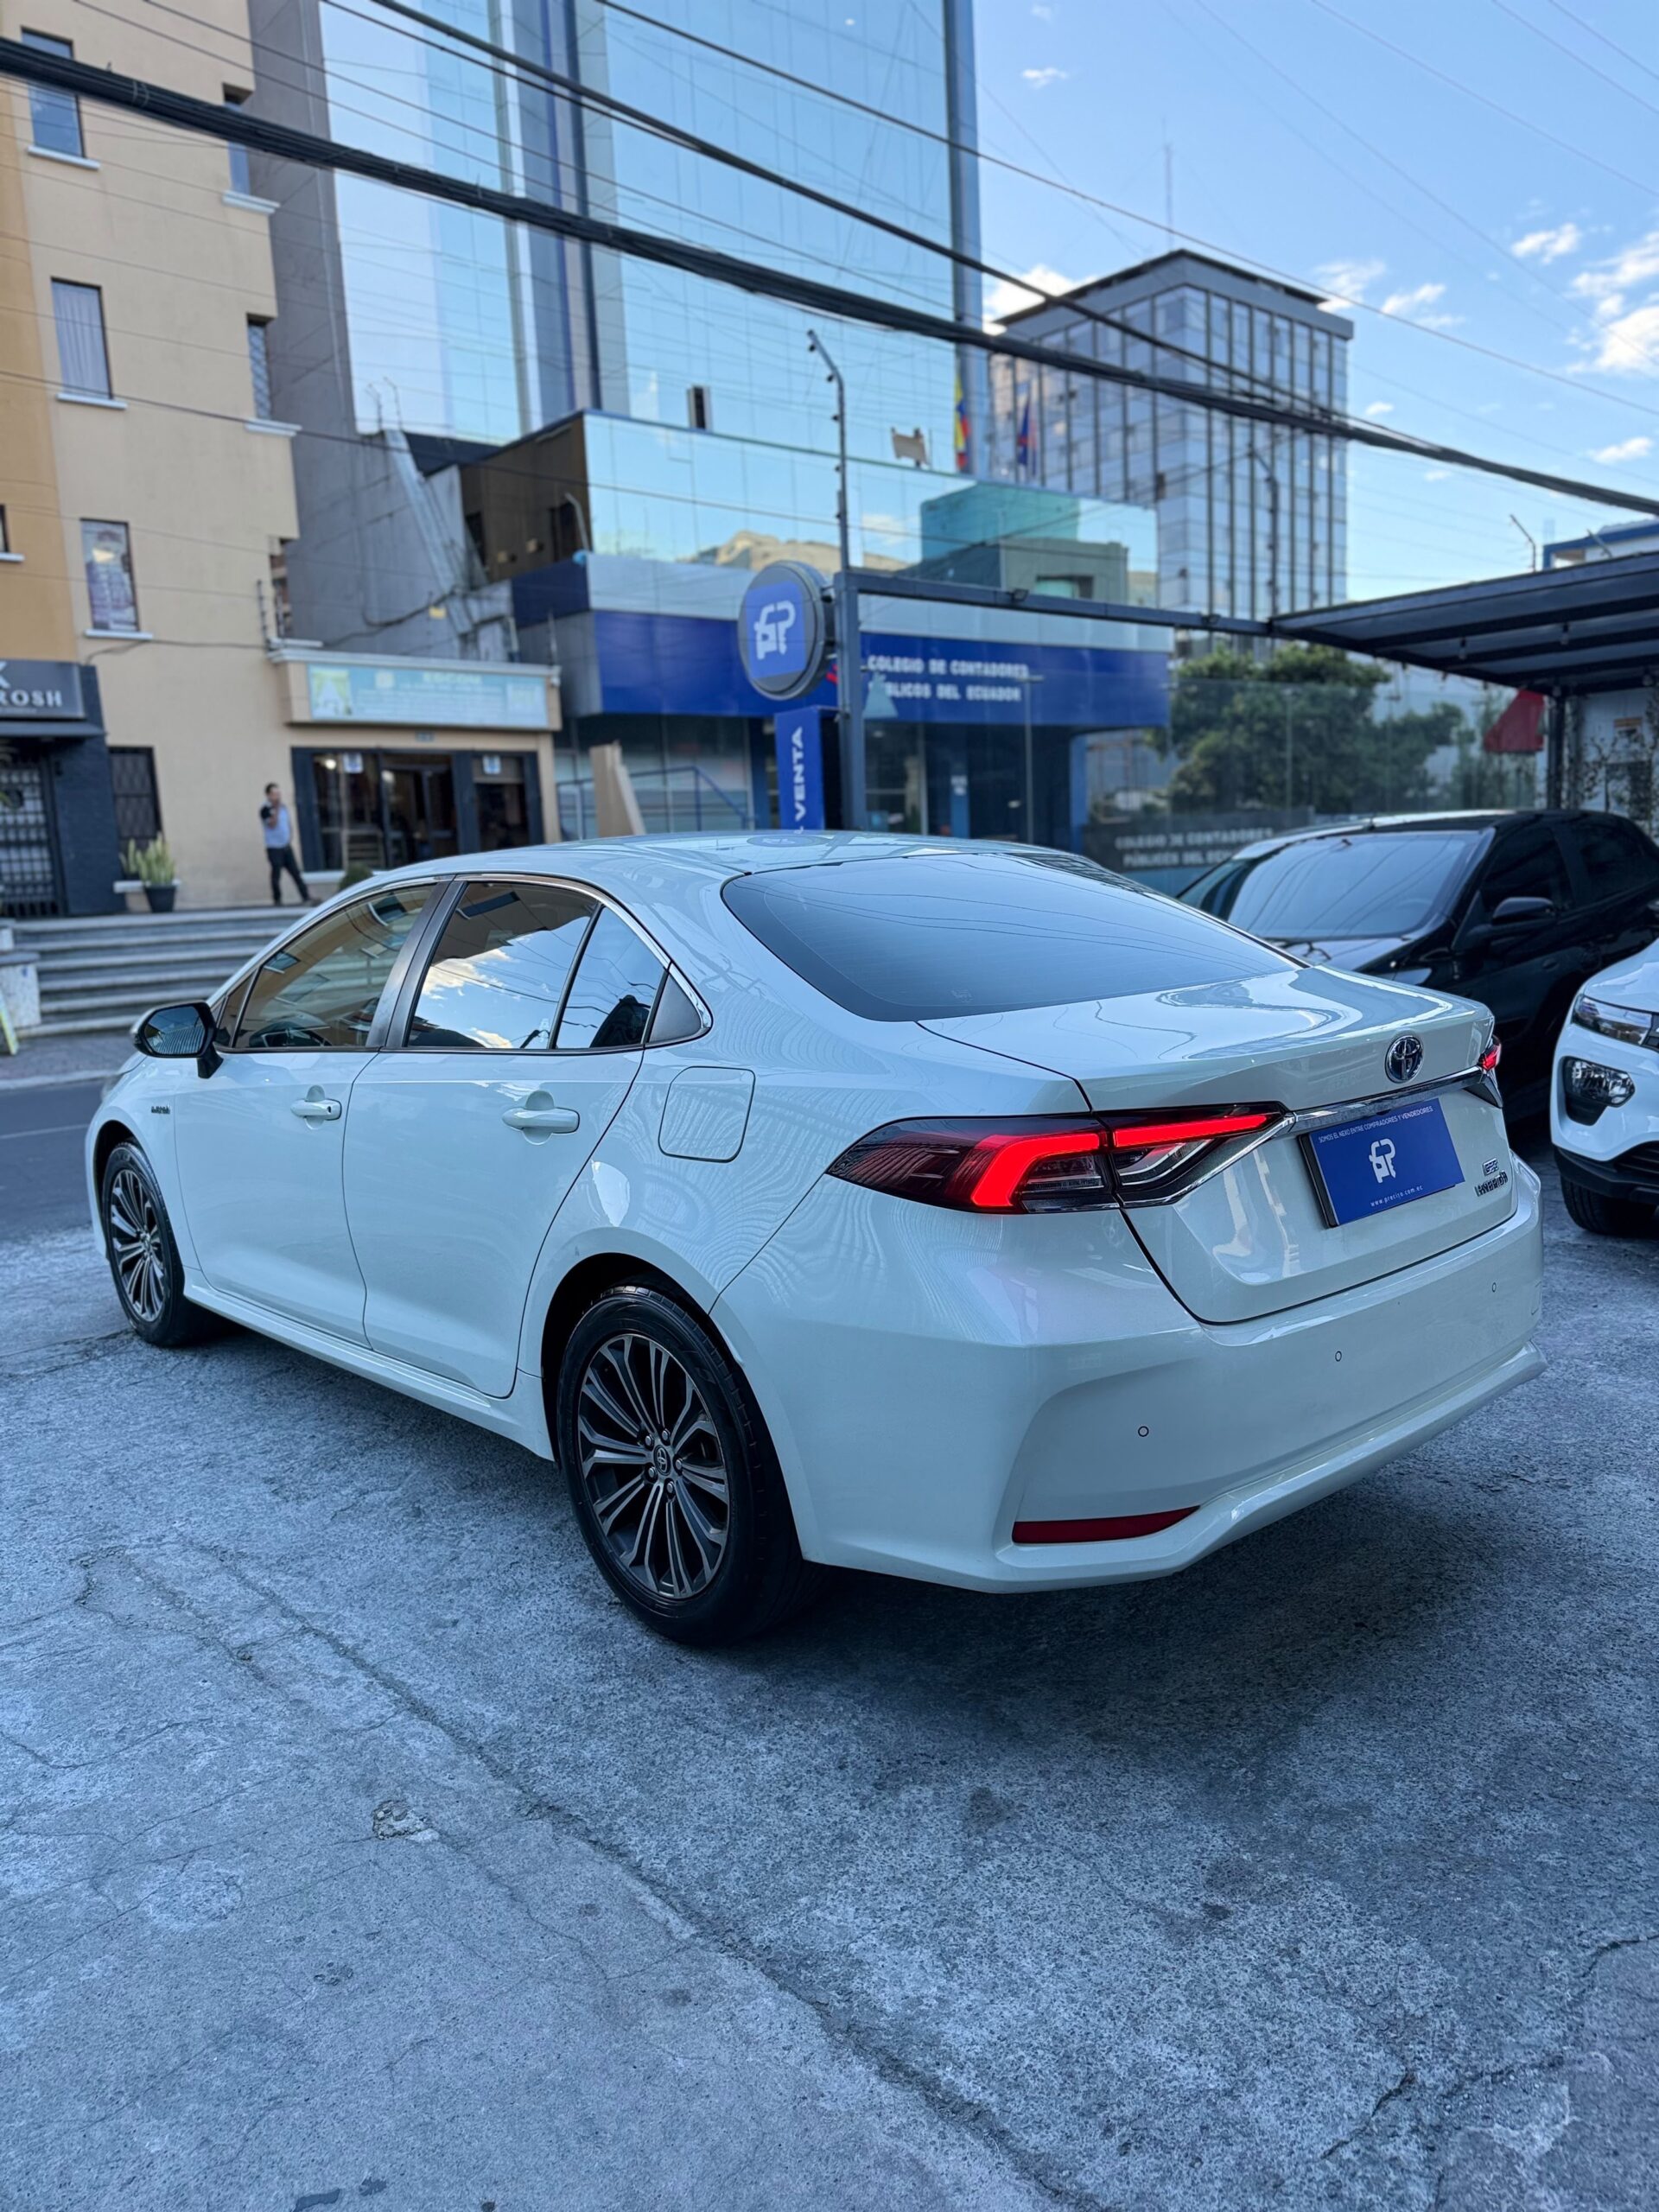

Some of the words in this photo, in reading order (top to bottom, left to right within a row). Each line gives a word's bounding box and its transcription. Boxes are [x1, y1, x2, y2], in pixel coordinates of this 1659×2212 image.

[868, 654, 925, 674] COLEGIO
[928, 658, 947, 676] DE
[950, 659, 1030, 678] CONTADORES
[868, 681, 931, 700] BLICOS
[936, 683, 961, 701] DEL
[965, 684, 1022, 702] ECUADOR
[791, 727, 806, 822] VENTA
[1319, 1134, 1334, 1144] SOMOS
[1338, 1129, 1351, 1139] NEXO
[1350, 1125, 1364, 1136] ENTRE
[1364, 1116, 1398, 1130] COMPRADORES
[1402, 1106, 1433, 1121] VENDEDORES
